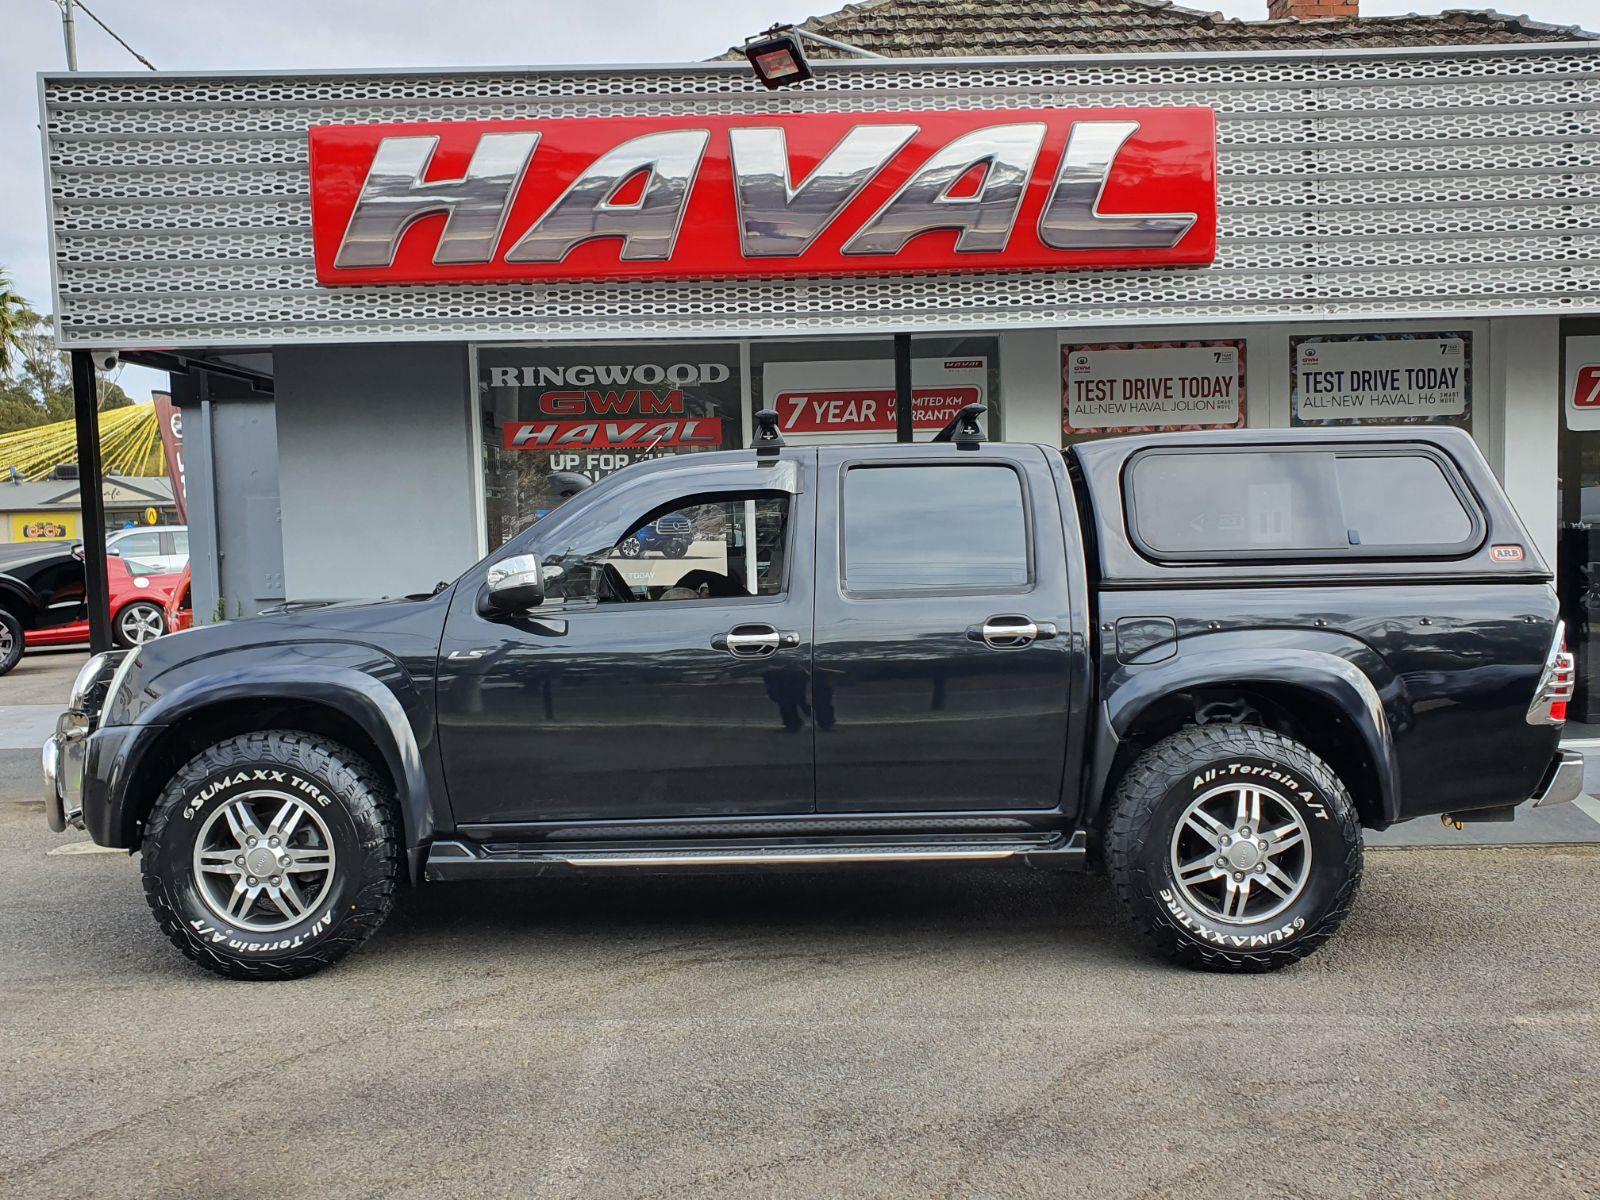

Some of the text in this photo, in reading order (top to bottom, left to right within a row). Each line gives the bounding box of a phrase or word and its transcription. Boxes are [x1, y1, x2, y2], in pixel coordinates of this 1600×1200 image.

[334, 121, 1198, 268] HAVAL
[1213, 352, 1221, 363] 7
[490, 363, 730, 387] RINGWOOD
[1302, 367, 1459, 393] TEST DRIVE TODAY
[887, 395, 963, 407] UMITED KM
[1074, 375, 1233, 402] TEST DRIVE TODAY
[1303, 392, 1436, 409] ALL-NEW HAVAL H6
[539, 390, 685, 415] GWM
[784, 397, 877, 429] 7 YEAR
[886, 408, 960, 421] WRRANTY
[1074, 400, 1216, 415] ALL-NEW HAVAL JOLION
[511, 421, 716, 446] HAVAL
[550, 454, 580, 470] UP
[587, 454, 630, 470] FOR
[1496, 549, 1519, 557] ARB
[190, 769, 331, 811] SUMAXX TIRE
[1192, 763, 1329, 820] All-Terrain A/T
[1159, 888, 1194, 929] TIRE
[190, 910, 332, 953] All-Terrain A/T
